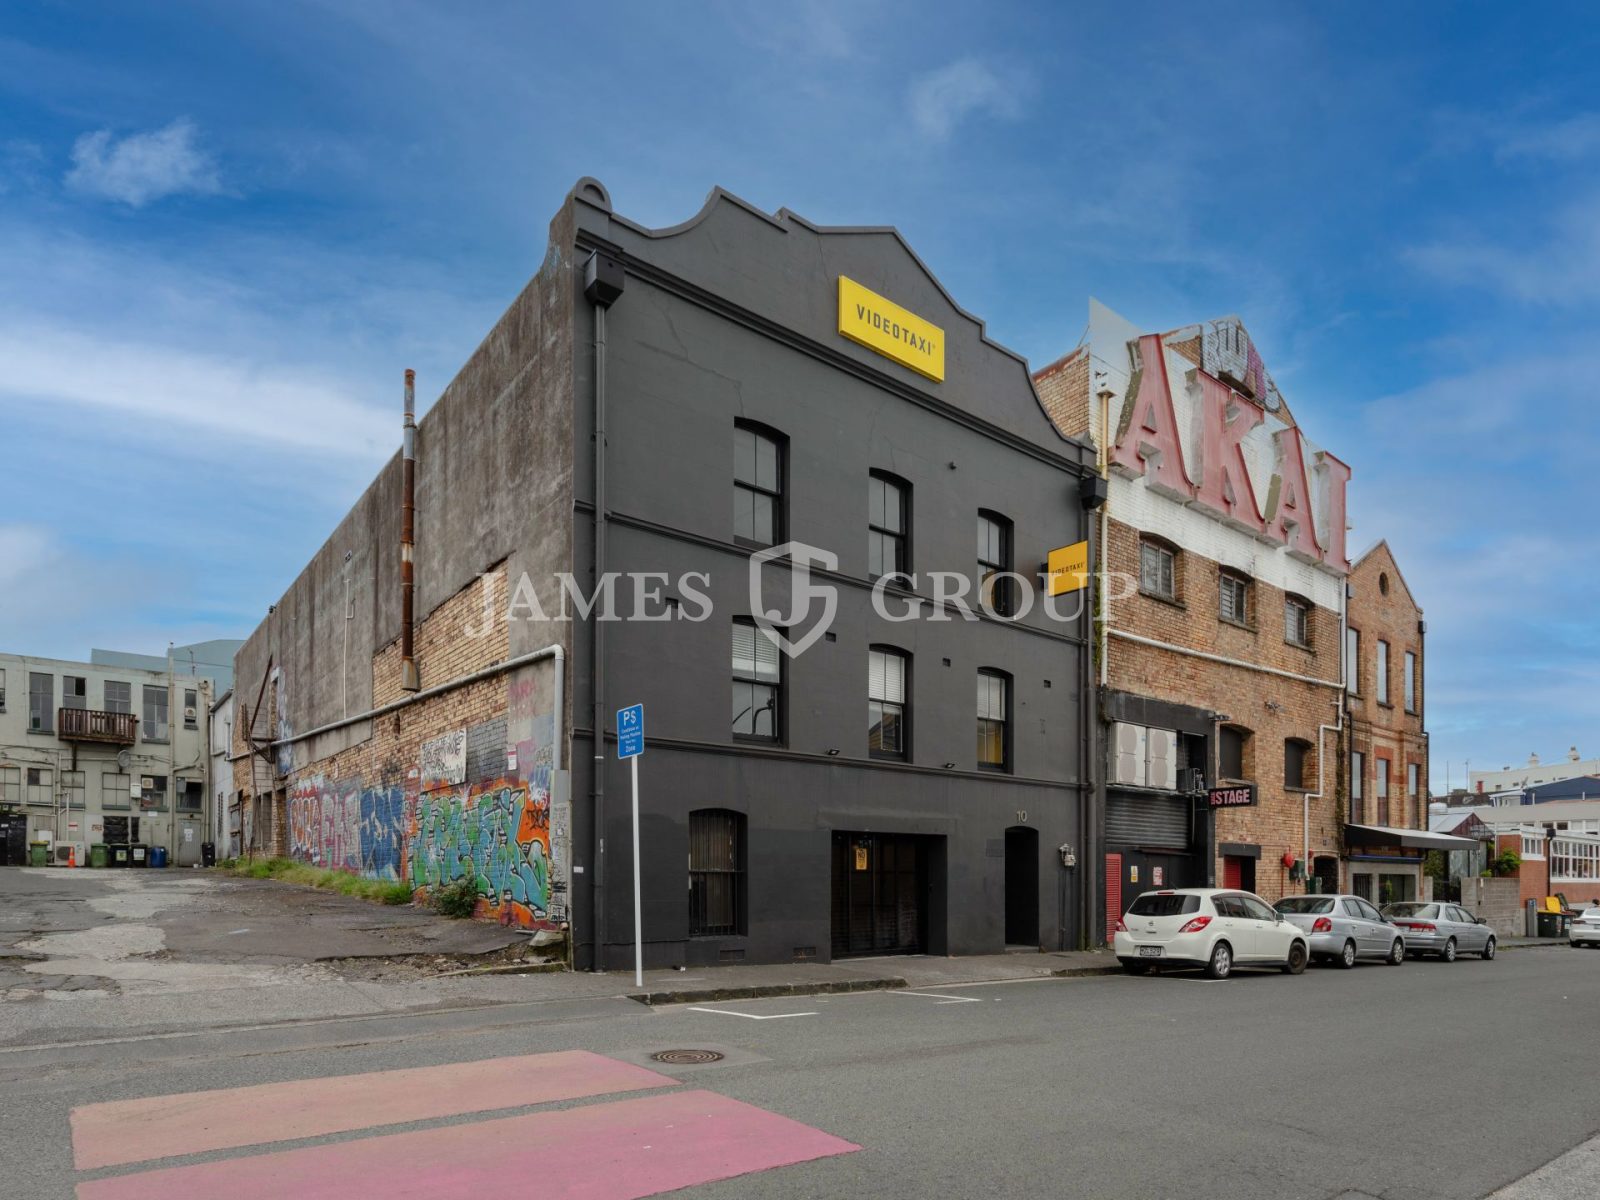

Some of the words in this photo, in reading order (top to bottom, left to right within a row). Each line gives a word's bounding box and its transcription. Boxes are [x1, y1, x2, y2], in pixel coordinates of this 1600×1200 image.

[856, 303, 932, 356] VIDEOTAXI
[1107, 333, 1352, 575] AKAI
[1215, 789, 1250, 805] STAGE
[1016, 810, 1028, 822] 10
